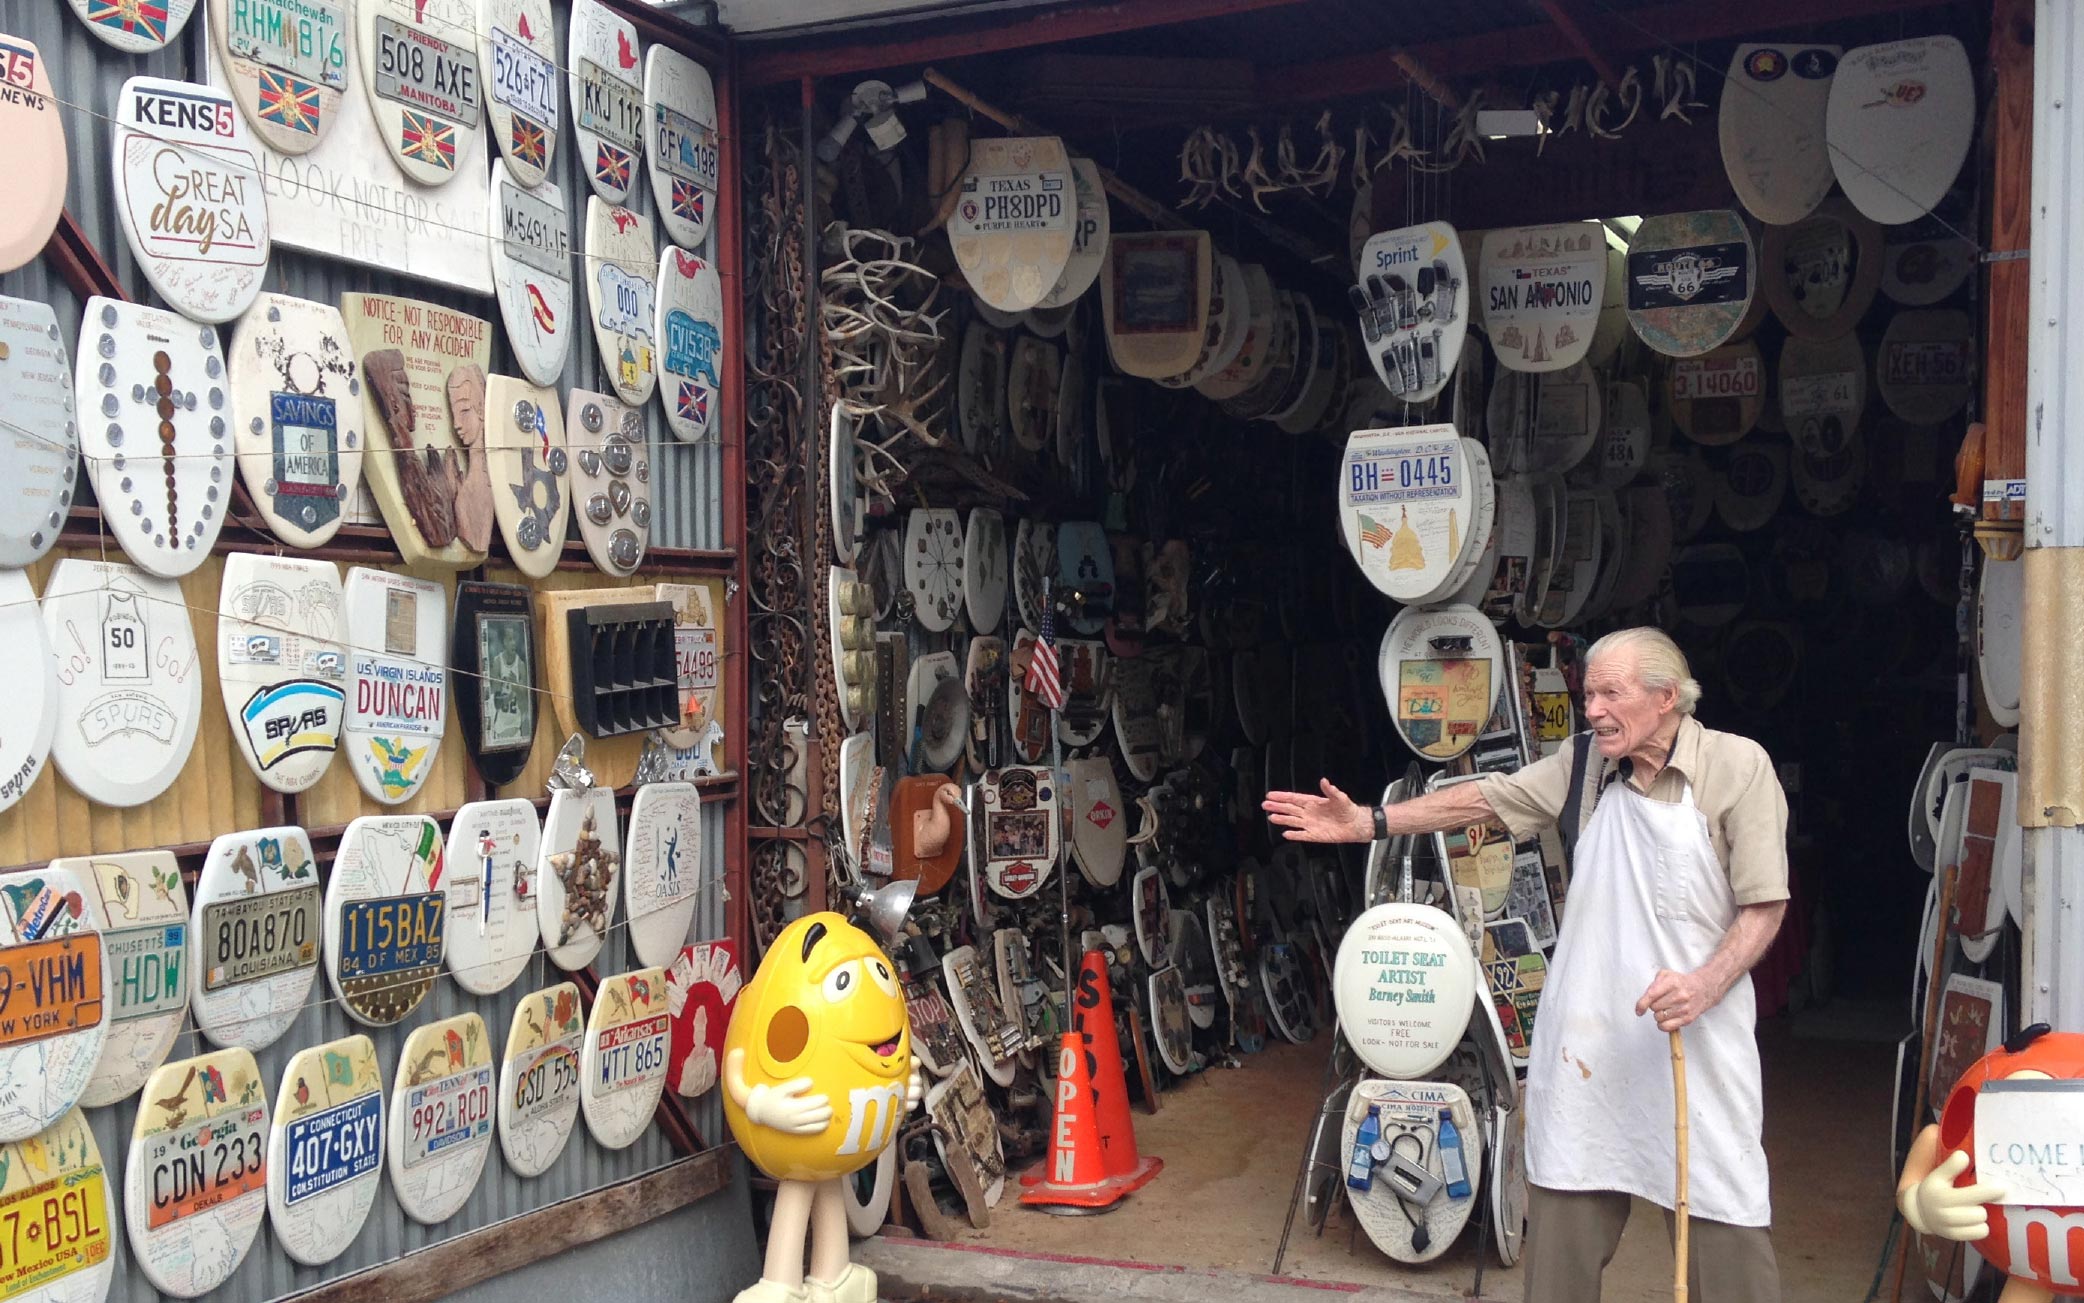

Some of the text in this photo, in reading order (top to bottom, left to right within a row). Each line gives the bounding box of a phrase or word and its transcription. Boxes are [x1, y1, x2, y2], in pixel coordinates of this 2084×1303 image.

[408, 30, 449, 53] FRIENDLY
[382, 33, 474, 104] 508 AXE
[496, 45, 523, 95] 526
[1, 88, 45, 112] NEWS
[400, 84, 457, 115] MANITOBA
[618, 96, 642, 140] 112
[660, 127, 684, 164] CFY
[694, 143, 715, 178] 198
[153, 149, 247, 206] GREAT
[989, 178, 1031, 192] TEXAS
[263, 151, 345, 215] LOOK
[353, 176, 389, 225] NOT
[395, 191, 429, 237] FOR
[984, 193, 1061, 220] PH8DPD
[151, 185, 254, 255] day SA
[1376, 245, 1420, 270] Sprint
[1532, 266, 1568, 277] TEXAS
[1490, 280, 1592, 311] SAN ANTONIO
[1678, 281, 1695, 293] 66
[363, 297, 484, 341] NOTICE NOT RESPONSIBLE
[384, 324, 475, 359] FOR ANY ACCIDENT
[273, 398, 334, 426] SAVINGS
[300, 434, 314, 452] OF
[286, 455, 329, 477] AMERICA
[1351, 456, 1451, 492] BH 0445
[111, 627, 134, 648] 50
[376, 665, 403, 679] VIRGIN
[405, 668, 442, 683] ISLANDS
[358, 678, 440, 721] DUNCAN
[265, 706, 327, 746] SPURS
[656, 880, 681, 898] OASIS
[218, 907, 306, 963] 80A870
[348, 900, 443, 952] 115BAZ
[233, 952, 293, 978] LOUISIANA
[343, 957, 360, 973] 84
[395, 948, 418, 965] MEX
[1361, 950, 1447, 967] TOILET SEAT
[121, 950, 181, 1007] HDW
[1378, 969, 1427, 985] ARTIST
[1368, 987, 1436, 1006] Barney Smith
[23, 1011, 60, 1032] YORK
[906, 995, 942, 1028] STOP
[1367, 1018, 1432, 1029] VISITORS WELCOME
[1388, 1040, 1403, 1048] NOT
[1405, 1040, 1420, 1048] FOR
[1422, 1041, 1440, 1049] SALE
[1390, 1029, 1411, 1038] FREE
[602, 1036, 664, 1085] WTT 865
[1381, 1103, 1402, 1111] CIMA
[1411, 1091, 1445, 1102] CIMA
[310, 1104, 362, 1134] CONNECTICUT
[413, 1085, 488, 1143] 992 RCD
[1055, 1047, 1077, 1183] OPEN
[1989, 1143, 2069, 1165] COME
[153, 1132, 261, 1209] CDN 233
[292, 1166, 348, 1197] CONSTITUTION
[20, 1180, 56, 1201] ALAMOS
[43, 1187, 100, 1252] BSL
[16, 1247, 78, 1279] Mexico USA
